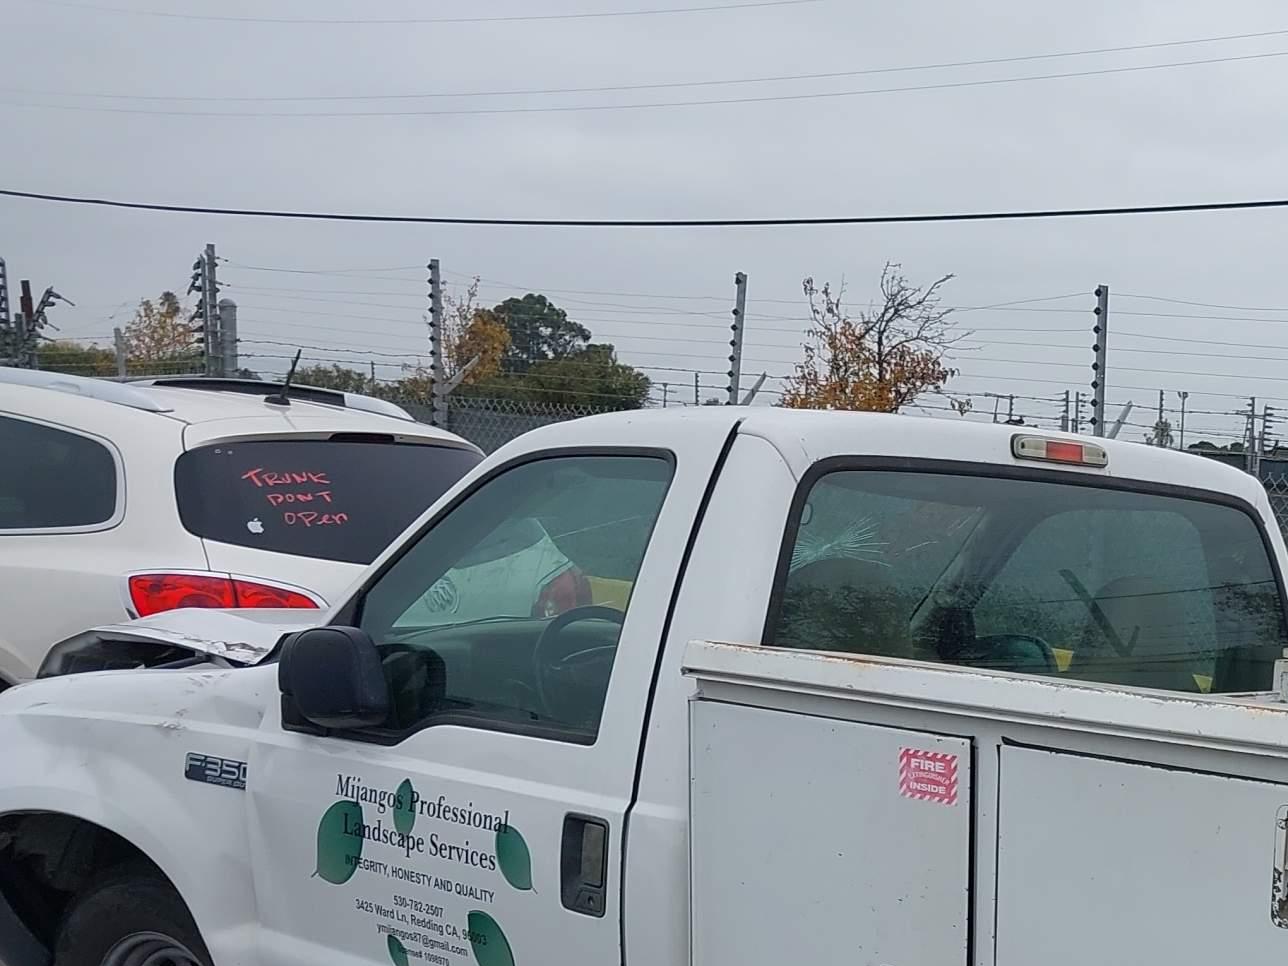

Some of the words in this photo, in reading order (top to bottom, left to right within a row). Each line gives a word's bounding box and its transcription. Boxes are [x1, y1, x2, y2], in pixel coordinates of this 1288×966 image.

[910, 758, 946, 773] FIRE
[335, 773, 403, 814] Mijangos
[408, 790, 509, 834] Professional
[909, 781, 947, 795] INSIDE
[343, 812, 424, 858] Landscape
[429, 833, 496, 871] Services
[345, 854, 389, 878] INTEGRITY,
[391, 867, 432, 888] HONESTY
[433, 877, 452, 893] AND
[455, 882, 494, 903] QUALITY
[355, 898, 373, 913] 3425
[375, 903, 395, 919] Ward
[411, 914, 444, 936] Redding
[393, 895, 444, 918] 530-782-2507
